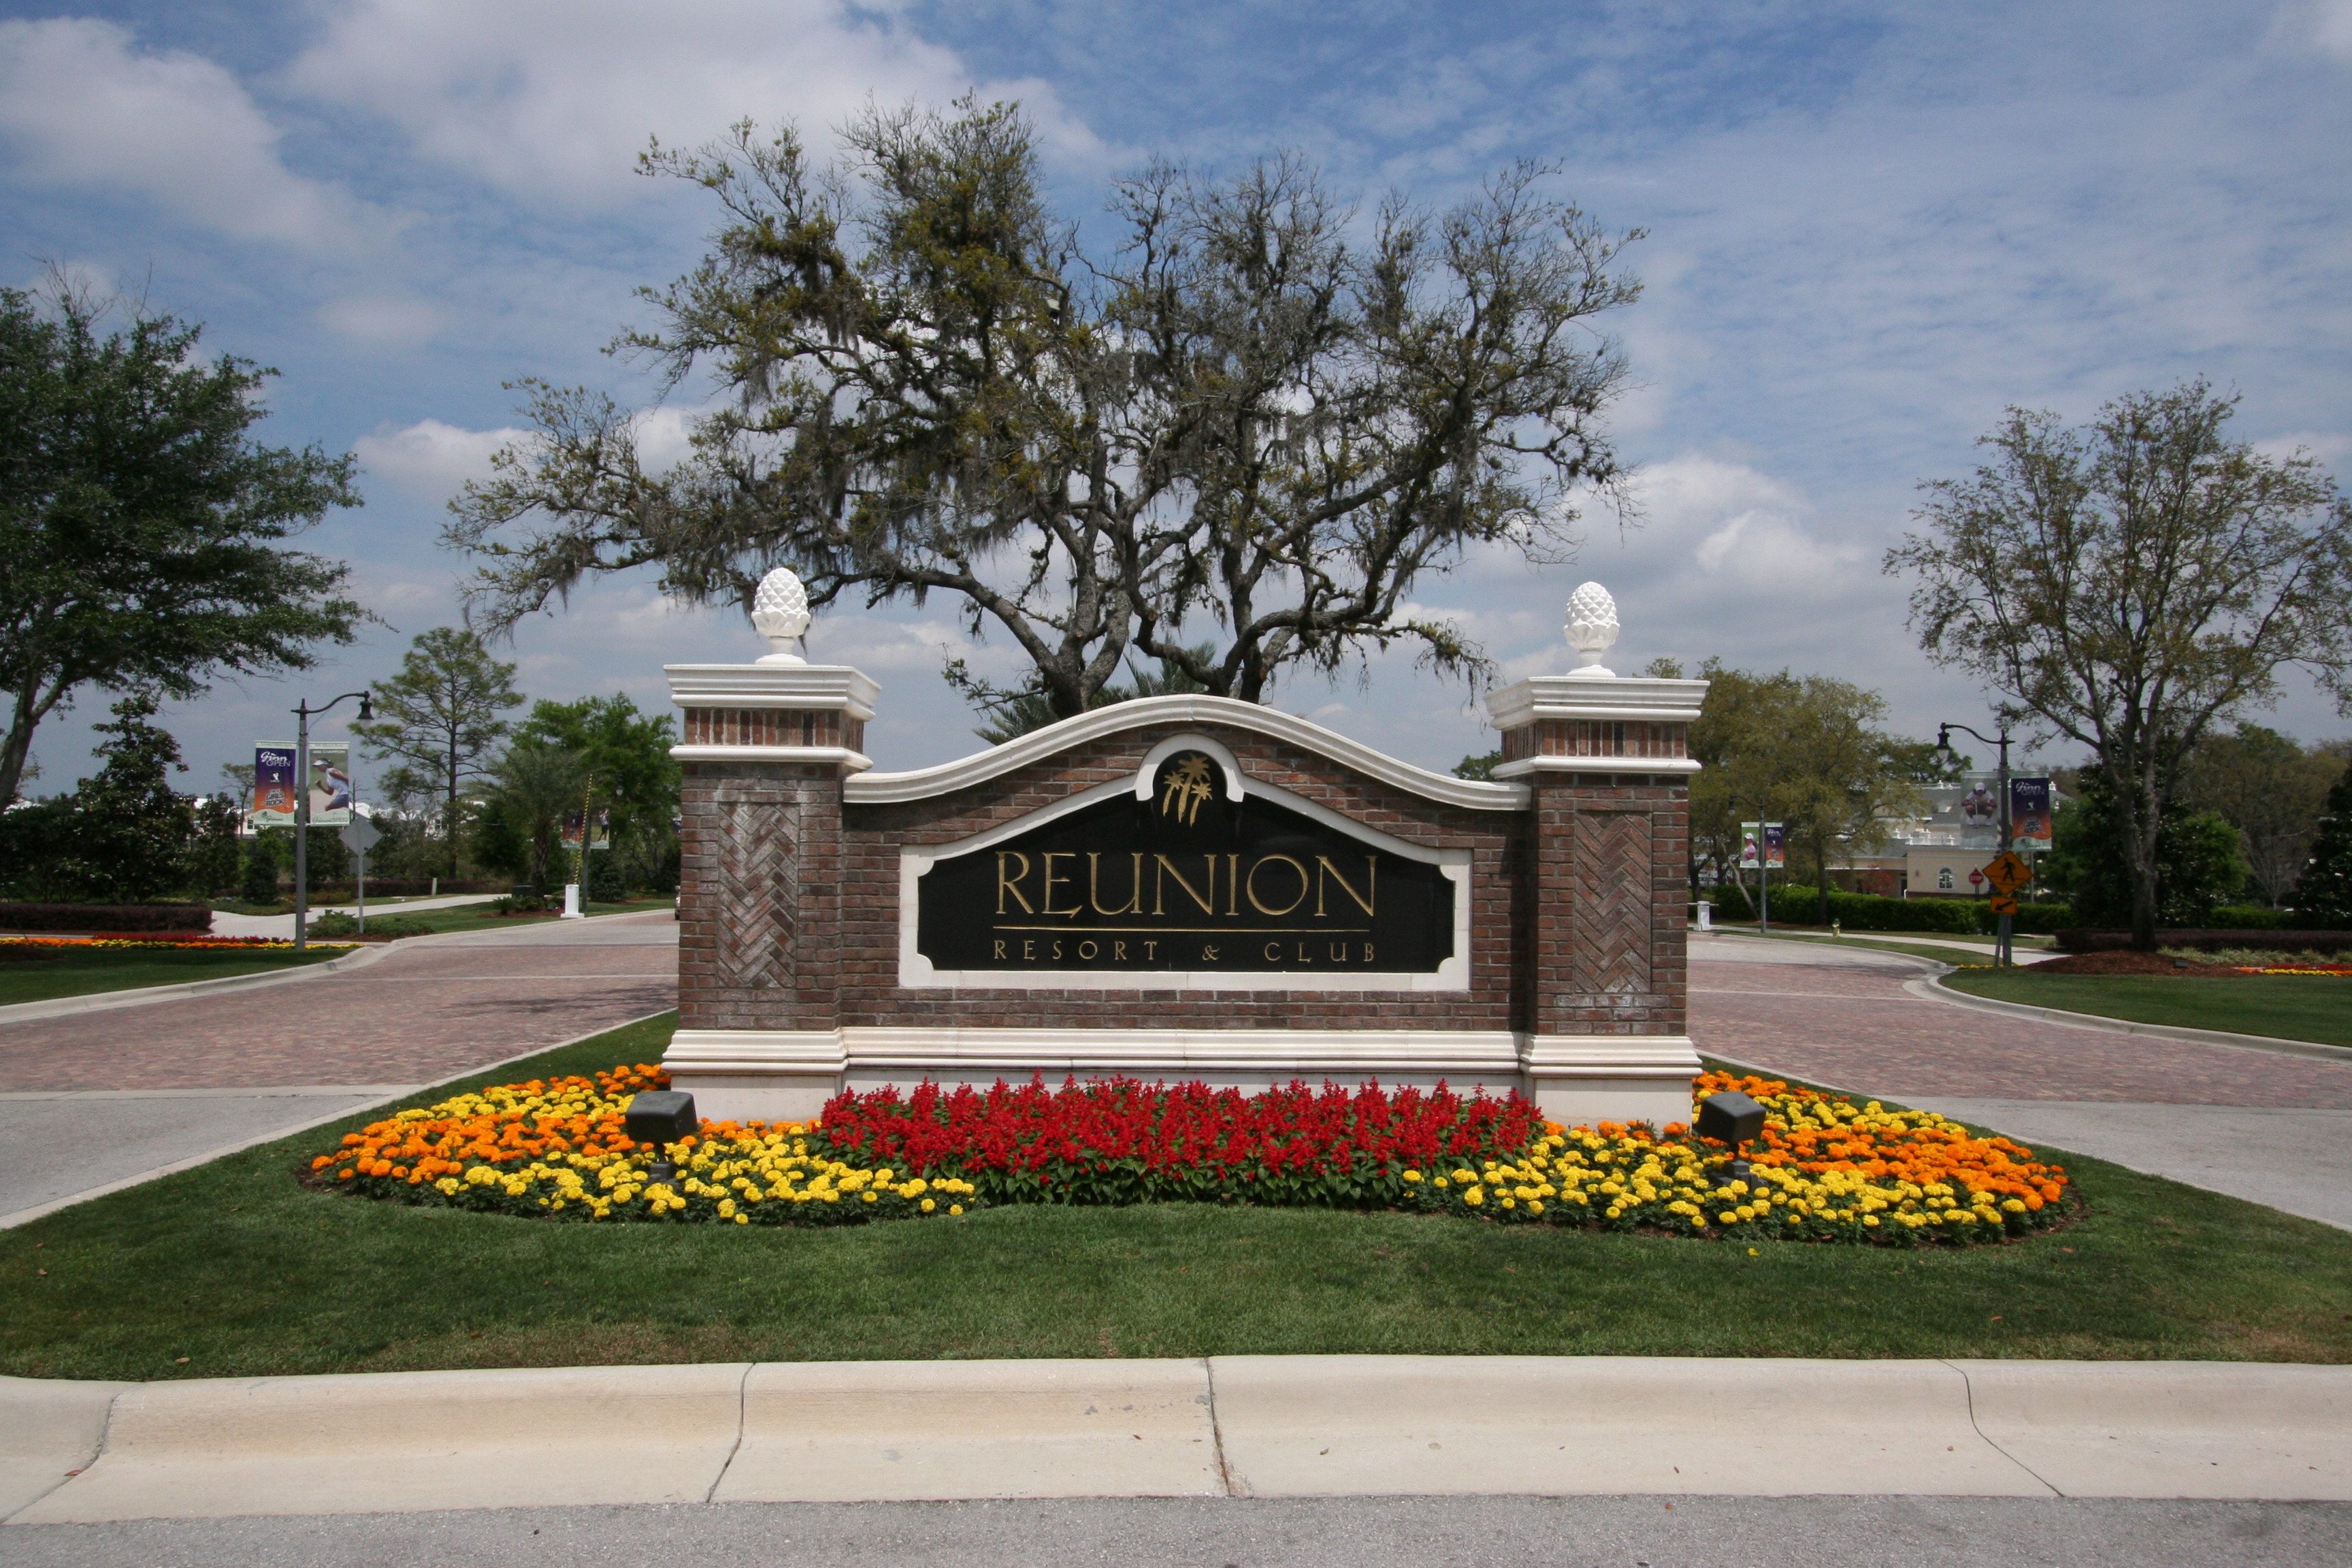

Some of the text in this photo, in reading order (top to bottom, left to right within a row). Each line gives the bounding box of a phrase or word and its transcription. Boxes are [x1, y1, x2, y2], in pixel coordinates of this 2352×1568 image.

[261, 751, 287, 762] Ginn
[266, 759, 291, 767] OPEN
[266, 791, 284, 800] GIRLS
[266, 799, 284, 807] ROCK
[995, 851, 1378, 919] REUNION
[994, 940, 1375, 963] RESORT & CLUB
